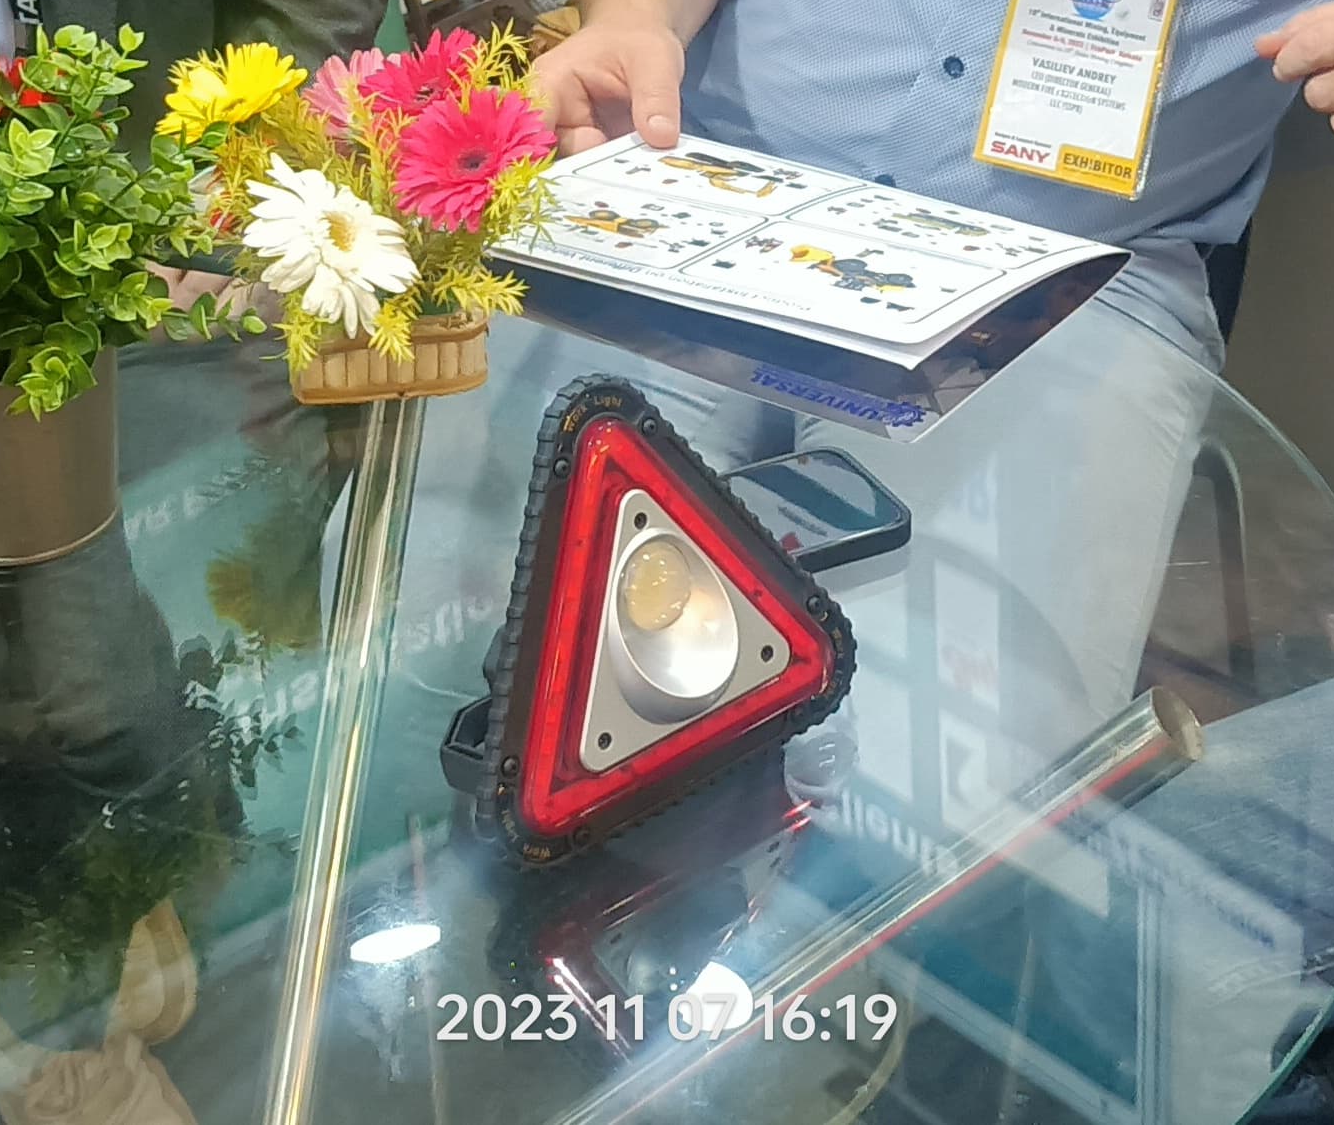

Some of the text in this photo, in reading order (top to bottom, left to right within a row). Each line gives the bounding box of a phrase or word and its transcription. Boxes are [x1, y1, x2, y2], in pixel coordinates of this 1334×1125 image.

[1076, 67, 1116, 84] ANDREY
[990, 139, 1050, 164] SANY
[1062, 152, 1133, 179] EXHIBITOR
[593, 394, 622, 407] Light
[747, 369, 881, 422] UNIVERSAL
